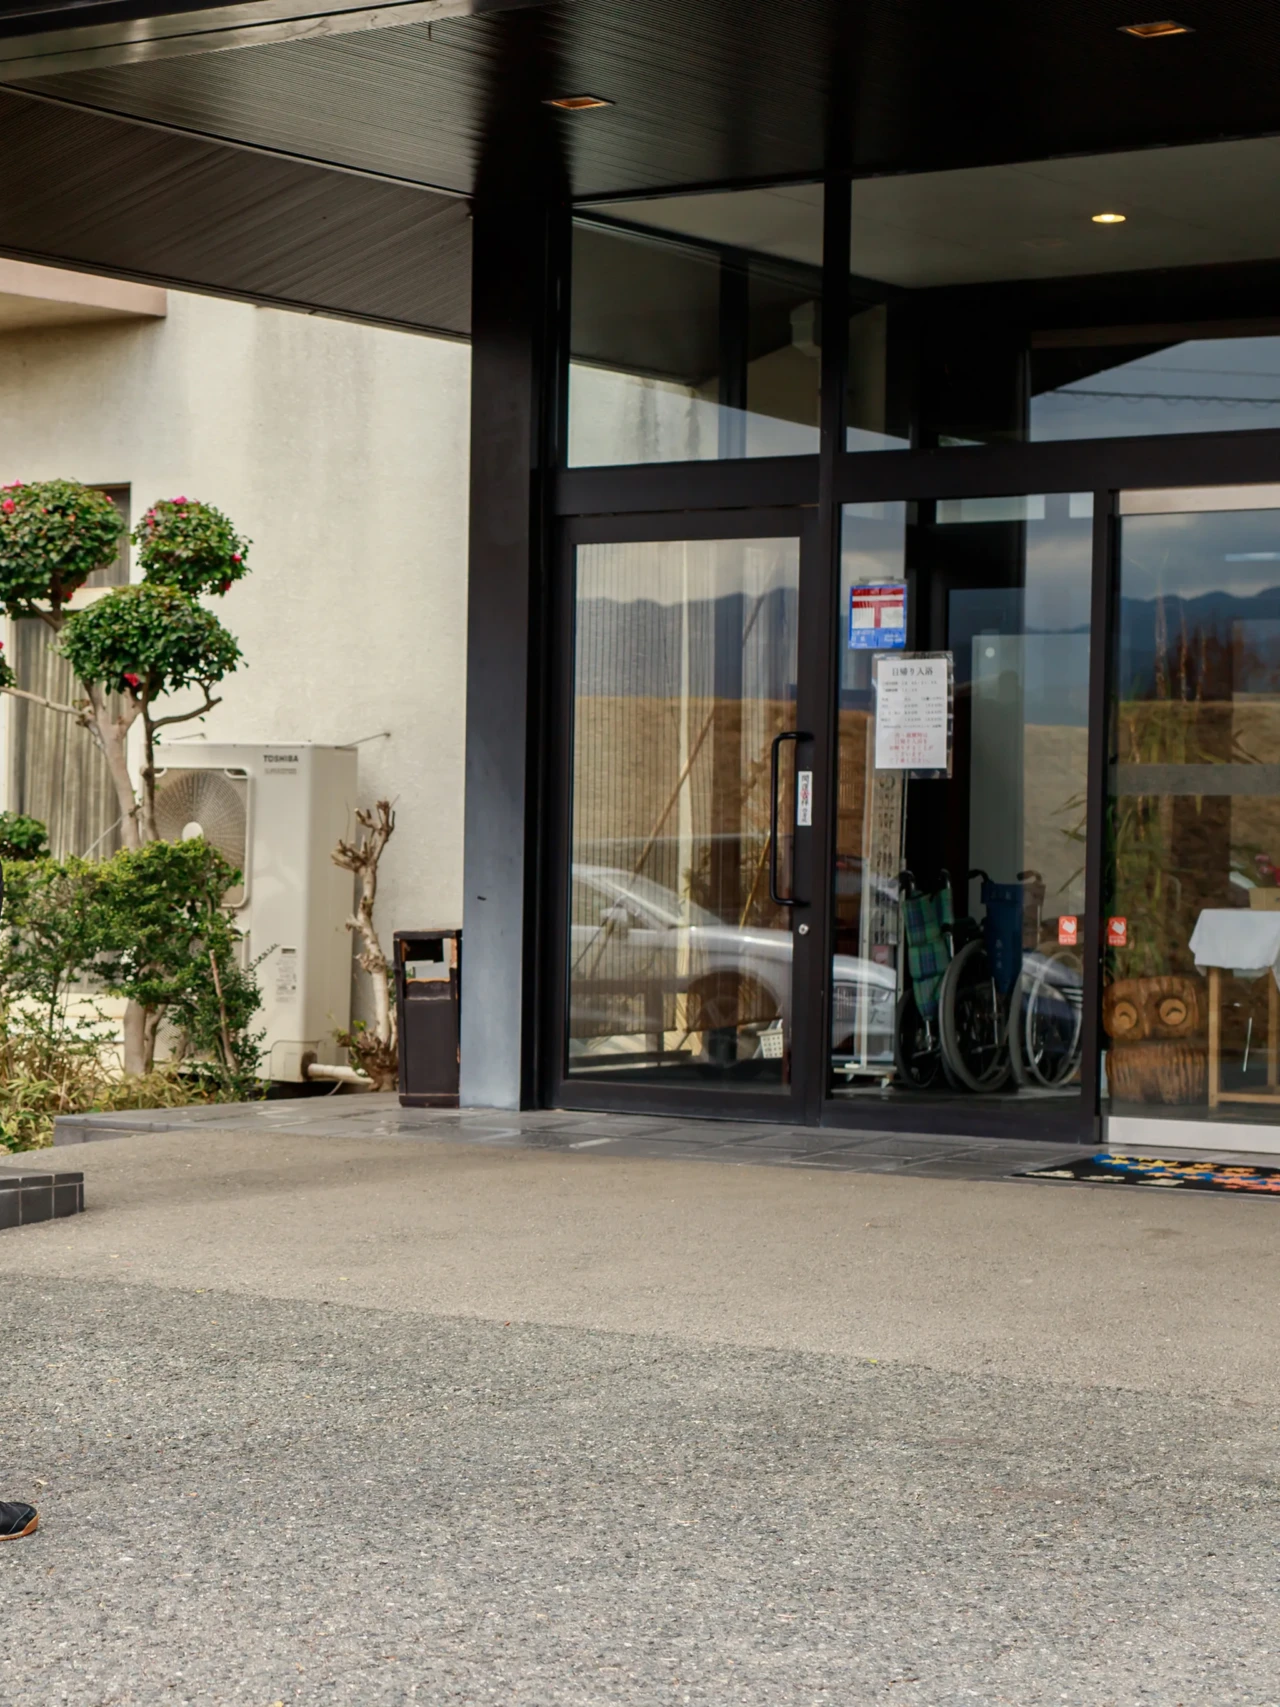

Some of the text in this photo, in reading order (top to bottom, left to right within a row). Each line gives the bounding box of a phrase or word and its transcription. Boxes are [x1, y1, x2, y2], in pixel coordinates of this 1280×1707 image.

[892, 667, 933, 676] 日帰り入浴
[263, 755, 299, 763] TOSHIBA
